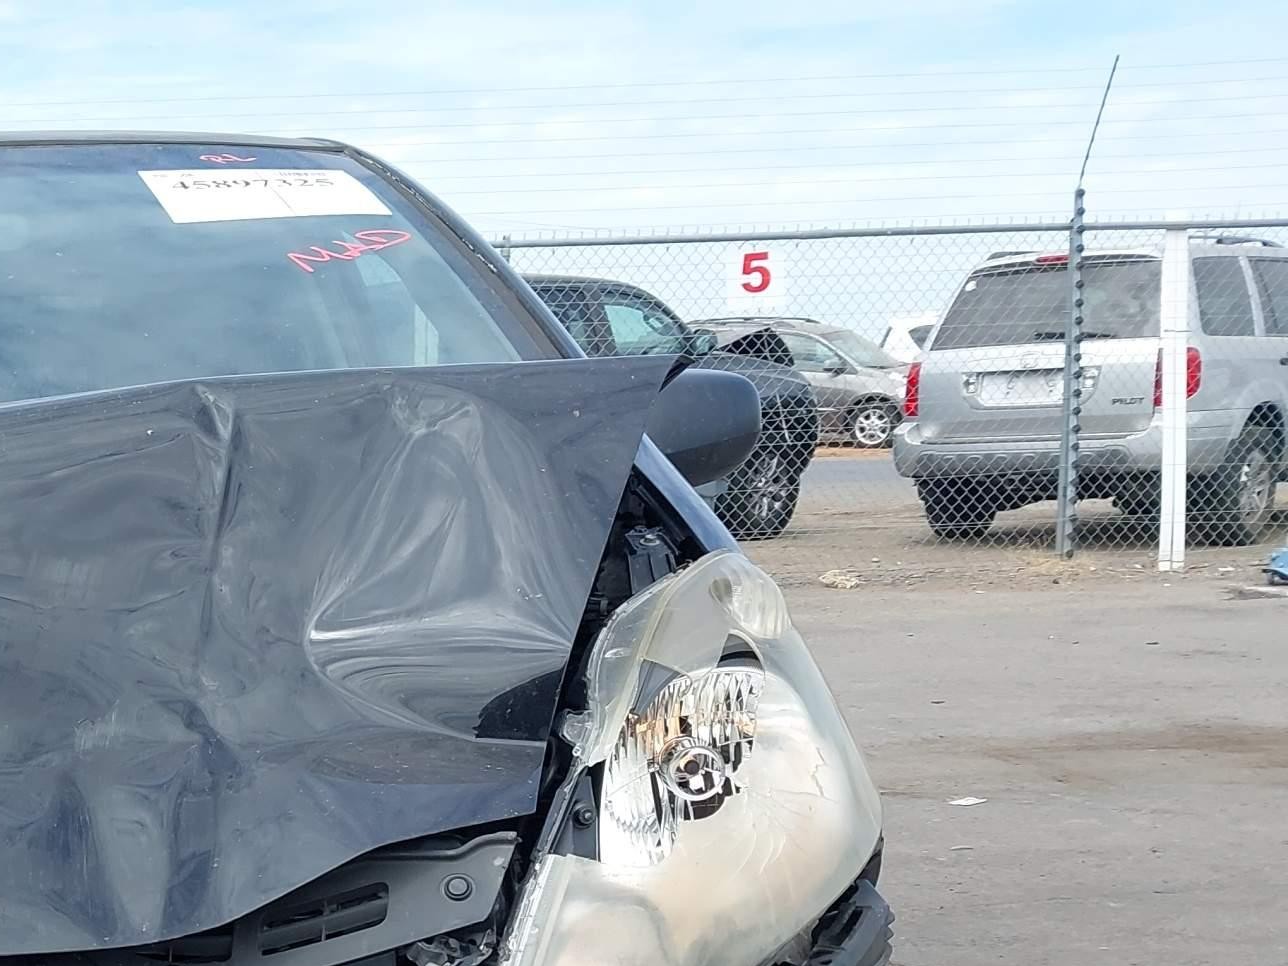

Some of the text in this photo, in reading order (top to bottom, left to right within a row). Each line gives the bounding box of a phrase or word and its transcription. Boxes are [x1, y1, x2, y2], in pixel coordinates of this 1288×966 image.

[171, 177, 335, 190] 45897325
[741, 251, 772, 294] 5
[1111, 397, 1145, 406] PILOT
